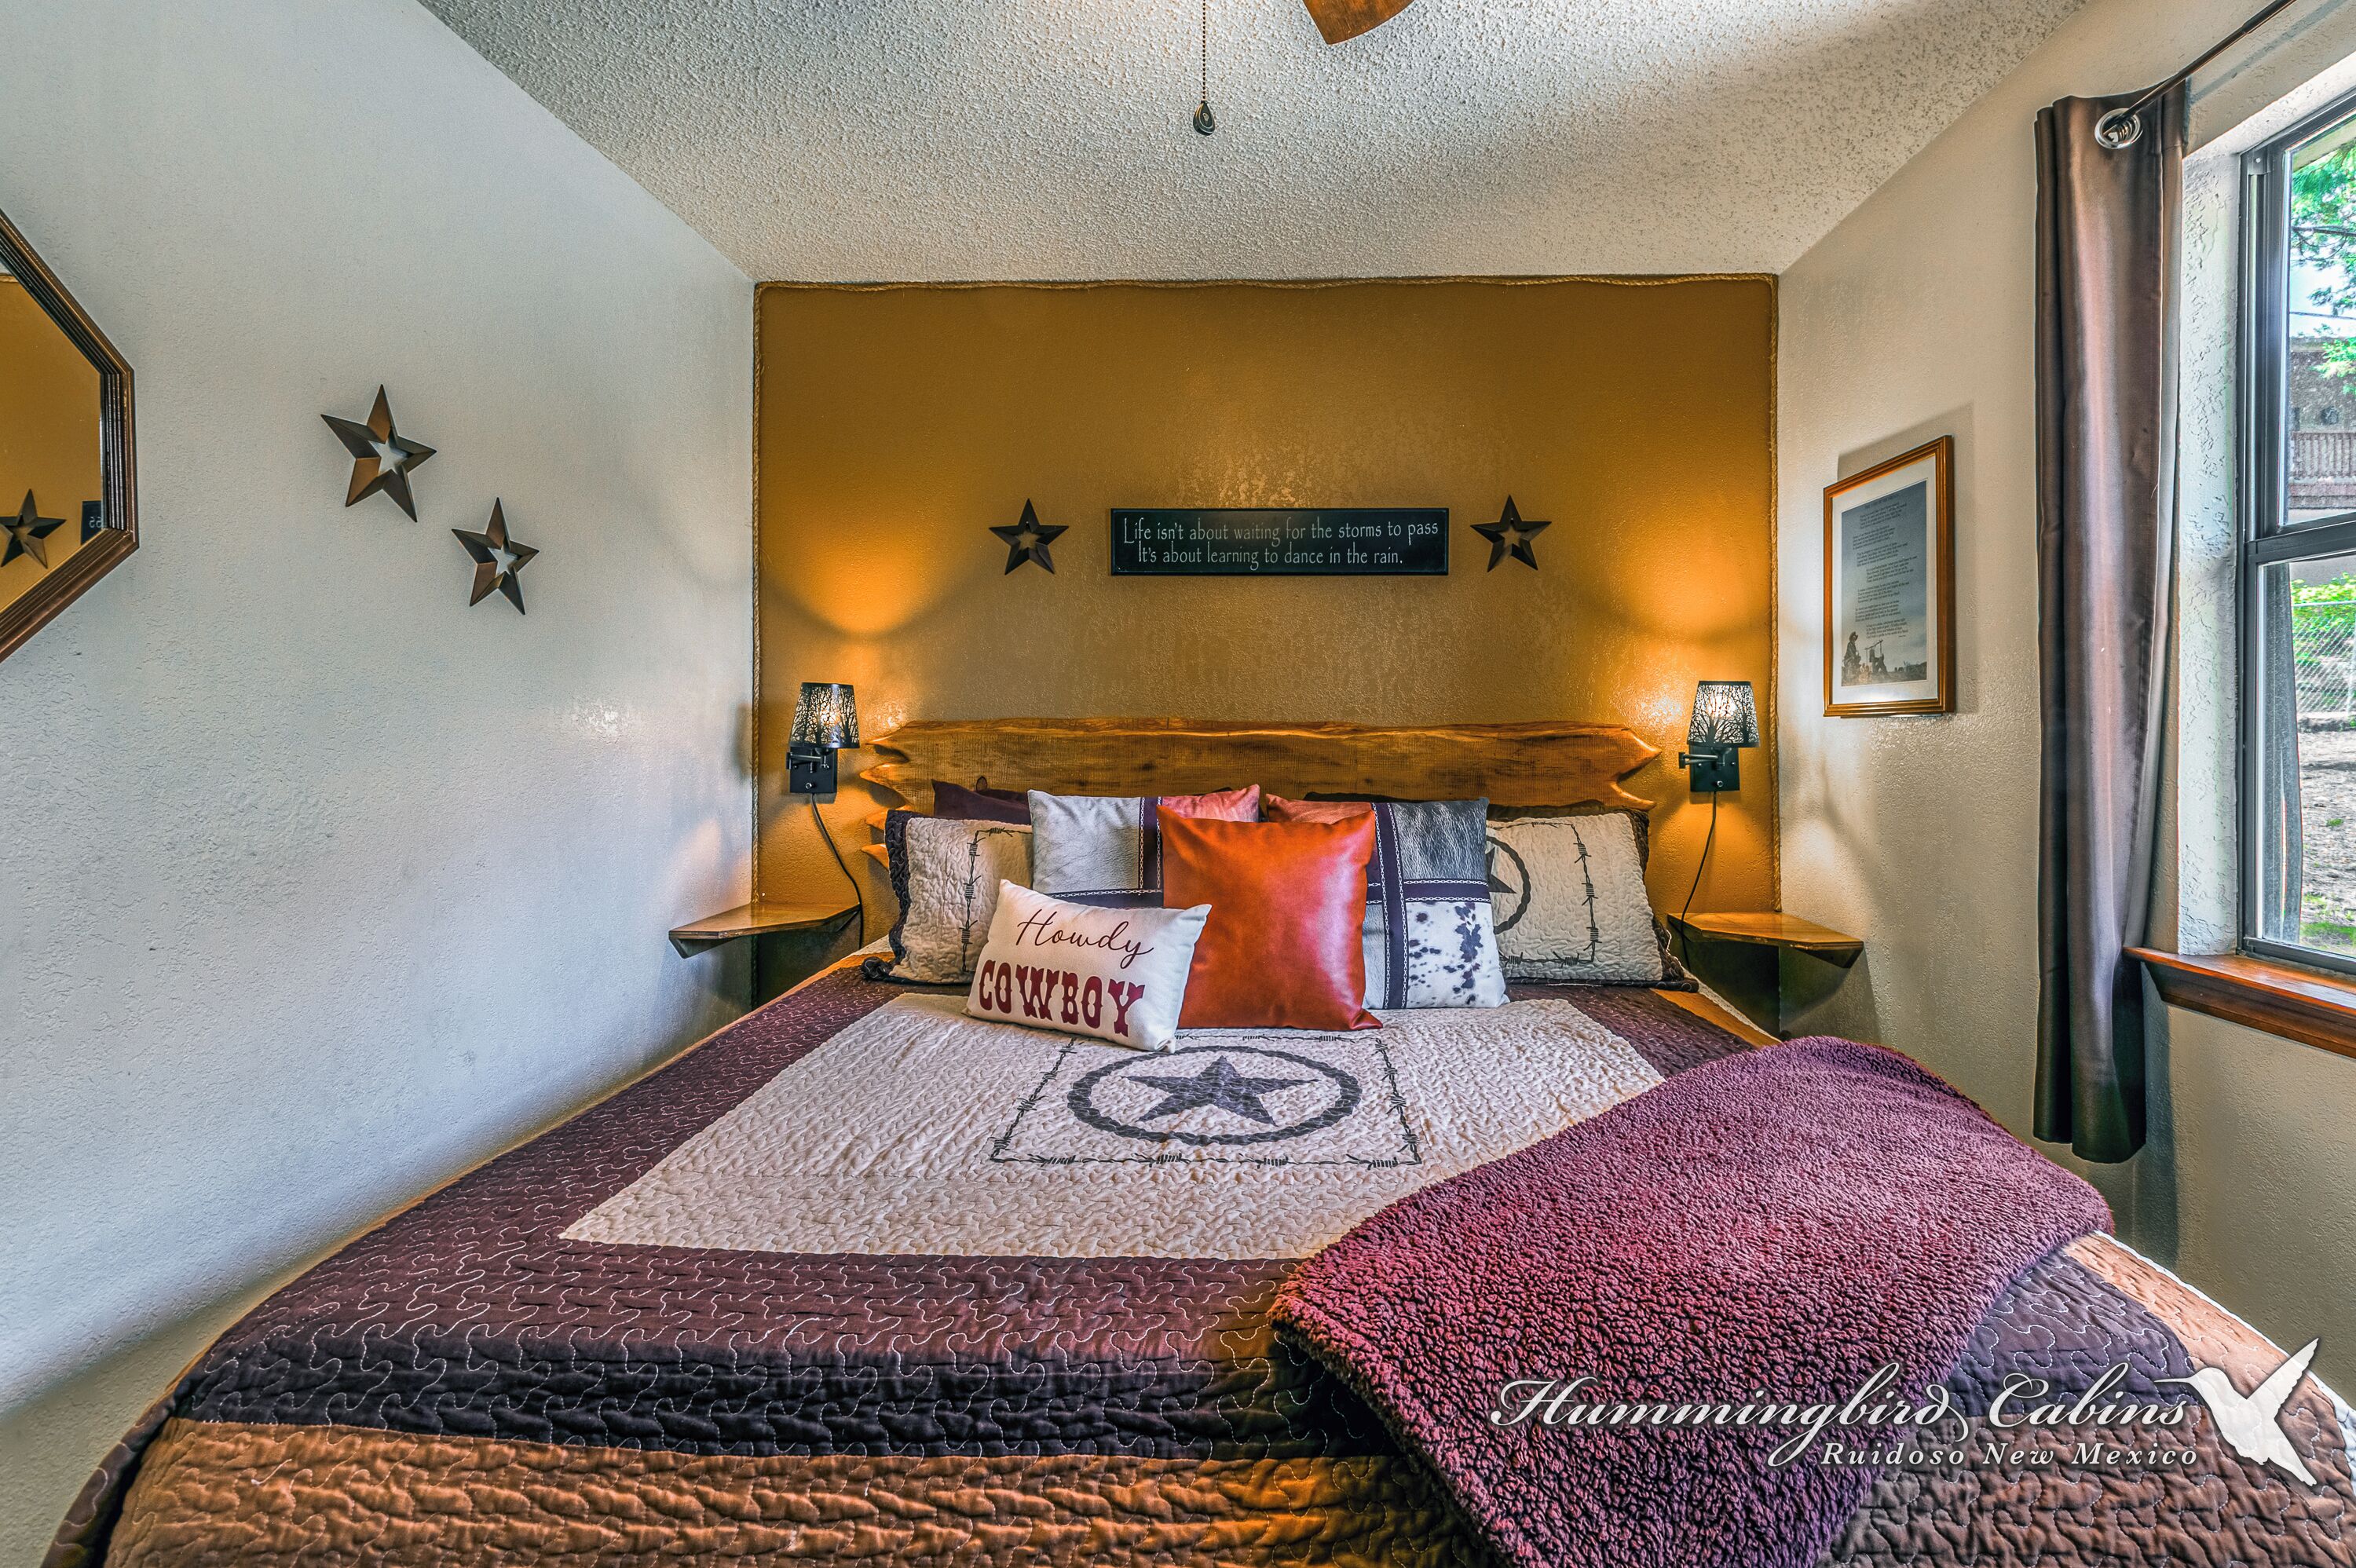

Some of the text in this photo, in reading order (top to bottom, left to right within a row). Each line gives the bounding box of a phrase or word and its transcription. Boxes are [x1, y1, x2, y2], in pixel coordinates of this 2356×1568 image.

[1124, 517, 1439, 546] Life isn't about waiting for the storms to pass
[1138, 541, 1403, 570] It's about learning to dance in the rain.
[1015, 908, 1154, 969] Howdy
[979, 959, 1145, 1037] COWBOY
